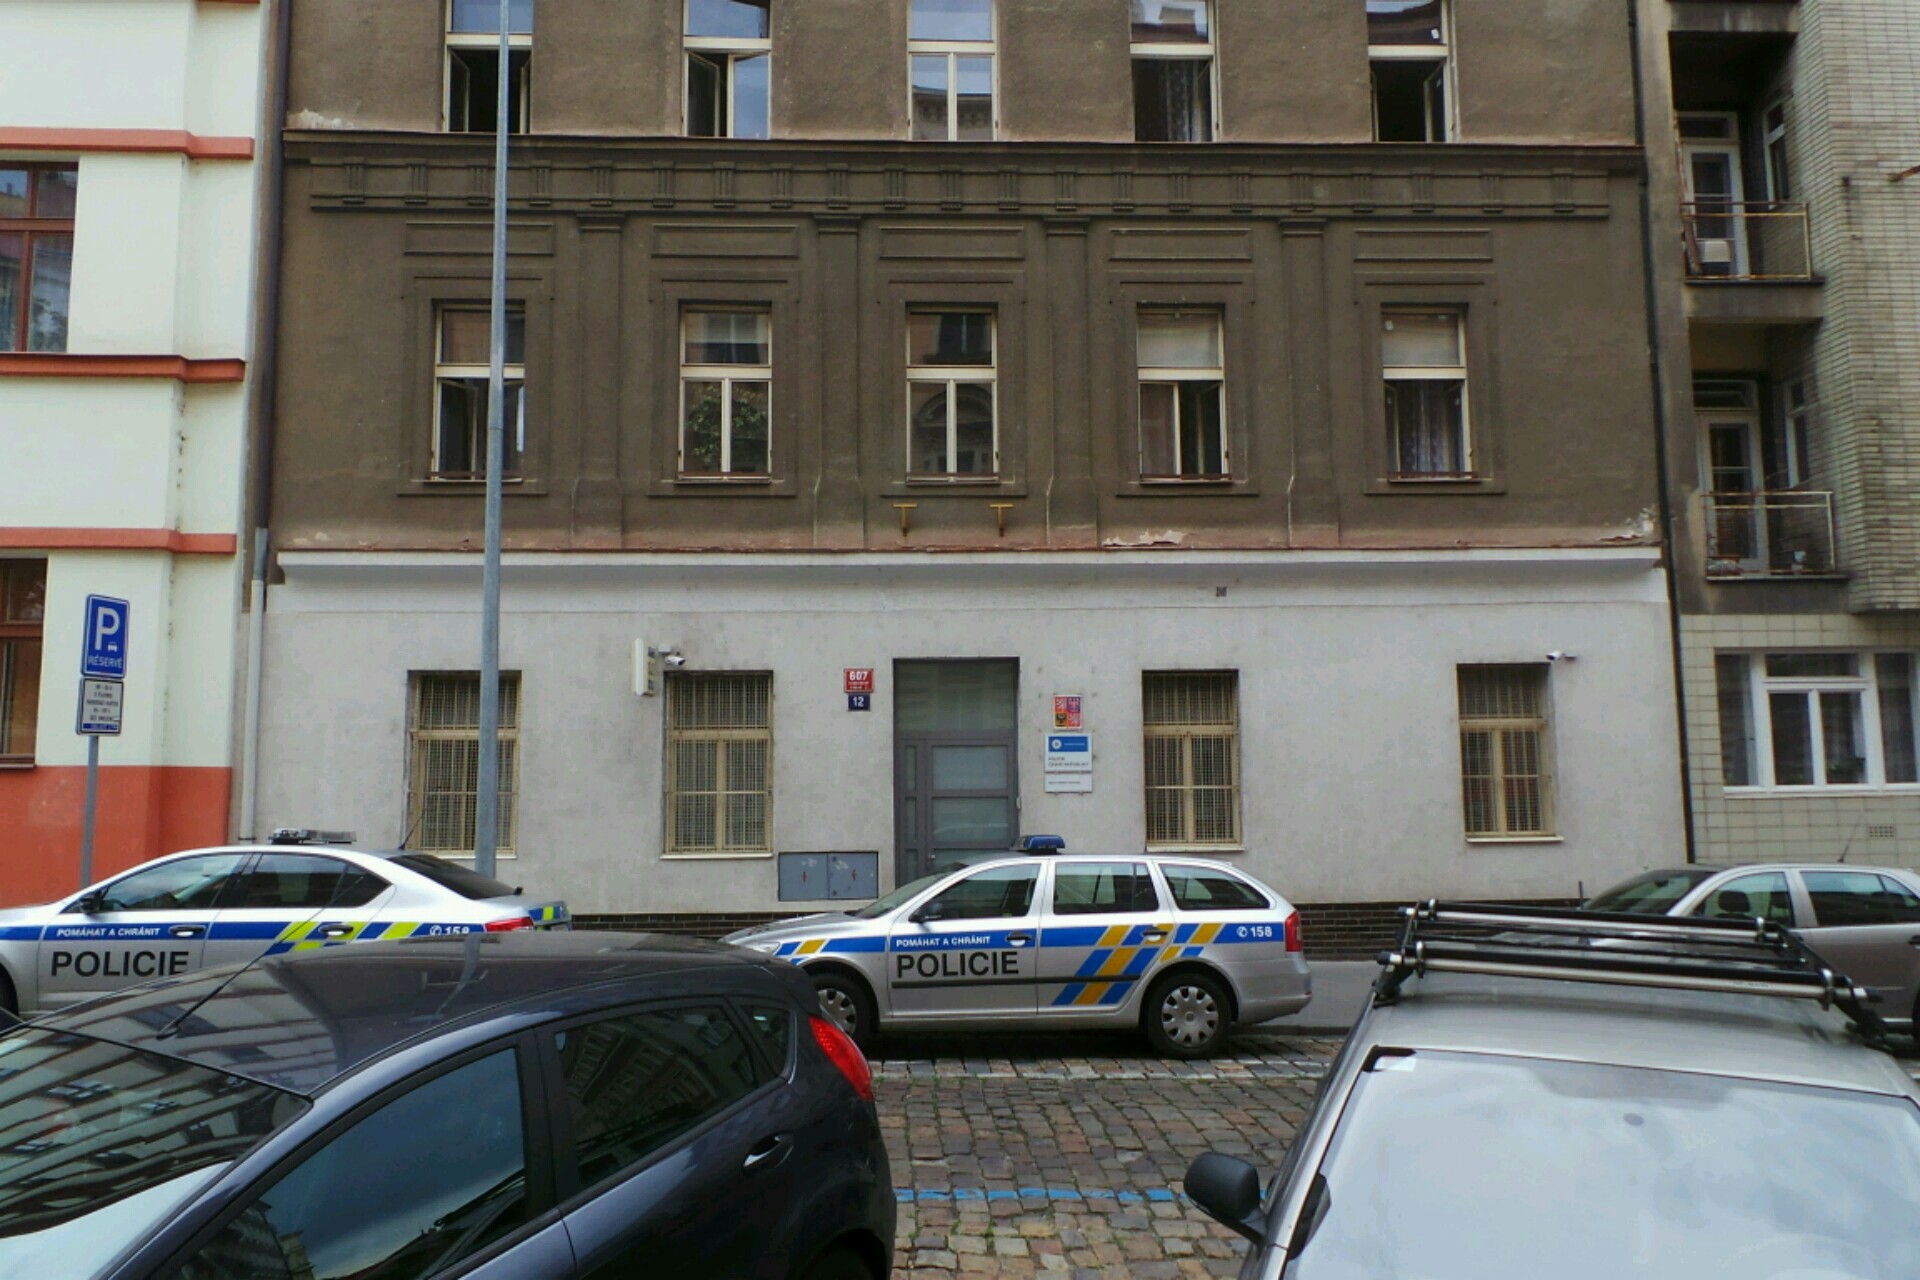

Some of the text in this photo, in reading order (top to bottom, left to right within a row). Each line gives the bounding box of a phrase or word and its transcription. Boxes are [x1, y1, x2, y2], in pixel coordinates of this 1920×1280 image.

[95, 606, 120, 651] P
[849, 671, 868, 681] 607
[852, 696, 865, 708] 12
[57, 926, 161, 937] POMÁHAT A CHRÁNIT
[1249, 926, 1273, 938] 158
[896, 936, 991, 948] POMÁHAT A CHRÁNIT
[51, 951, 189, 977] POLICIE
[896, 951, 1019, 978] POLICIE
